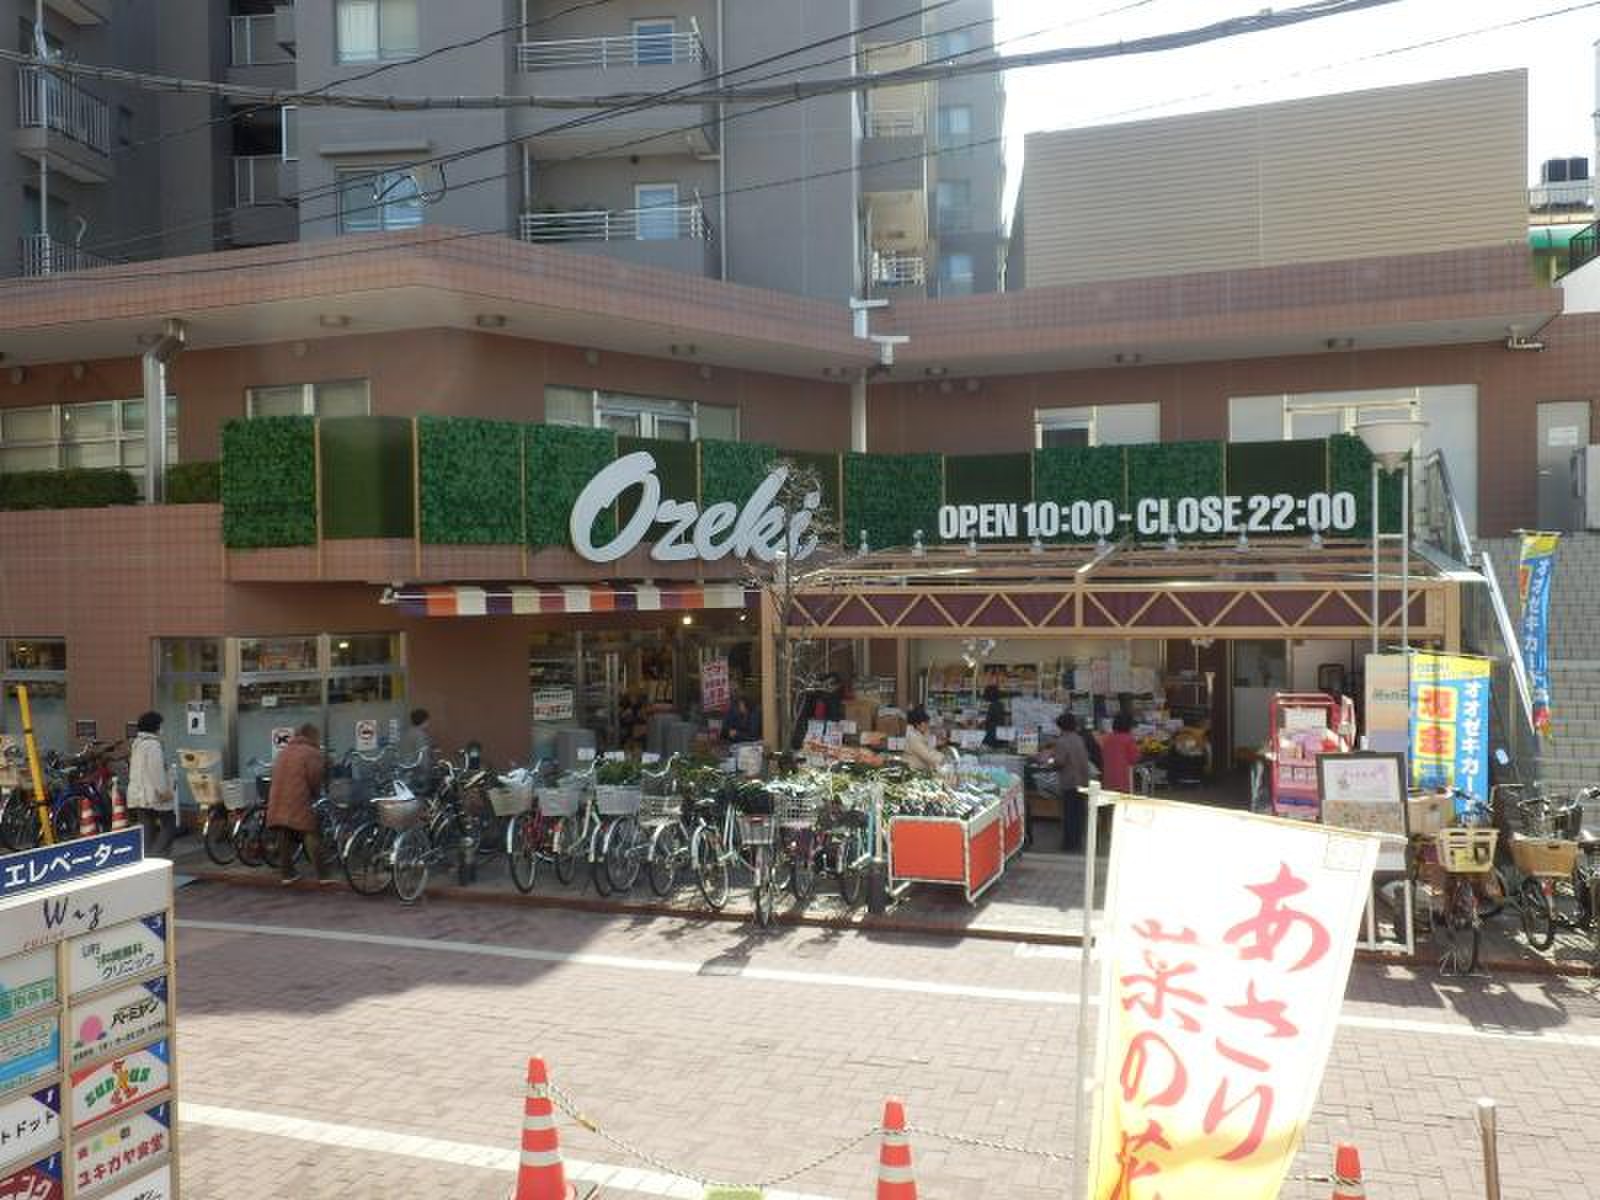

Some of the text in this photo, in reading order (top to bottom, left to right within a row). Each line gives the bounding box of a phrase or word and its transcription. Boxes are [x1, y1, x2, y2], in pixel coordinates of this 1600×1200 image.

[570, 451, 820, 563] Ozeki
[938, 503, 1018, 539] OPEN
[1022, 500, 1115, 537] 10:00
[1137, 496, 1241, 535] CLOSE
[1247, 491, 1356, 532] 22:00
[4, 843, 134, 889] エレベーター
[1203, 861, 1331, 1161] あさり
